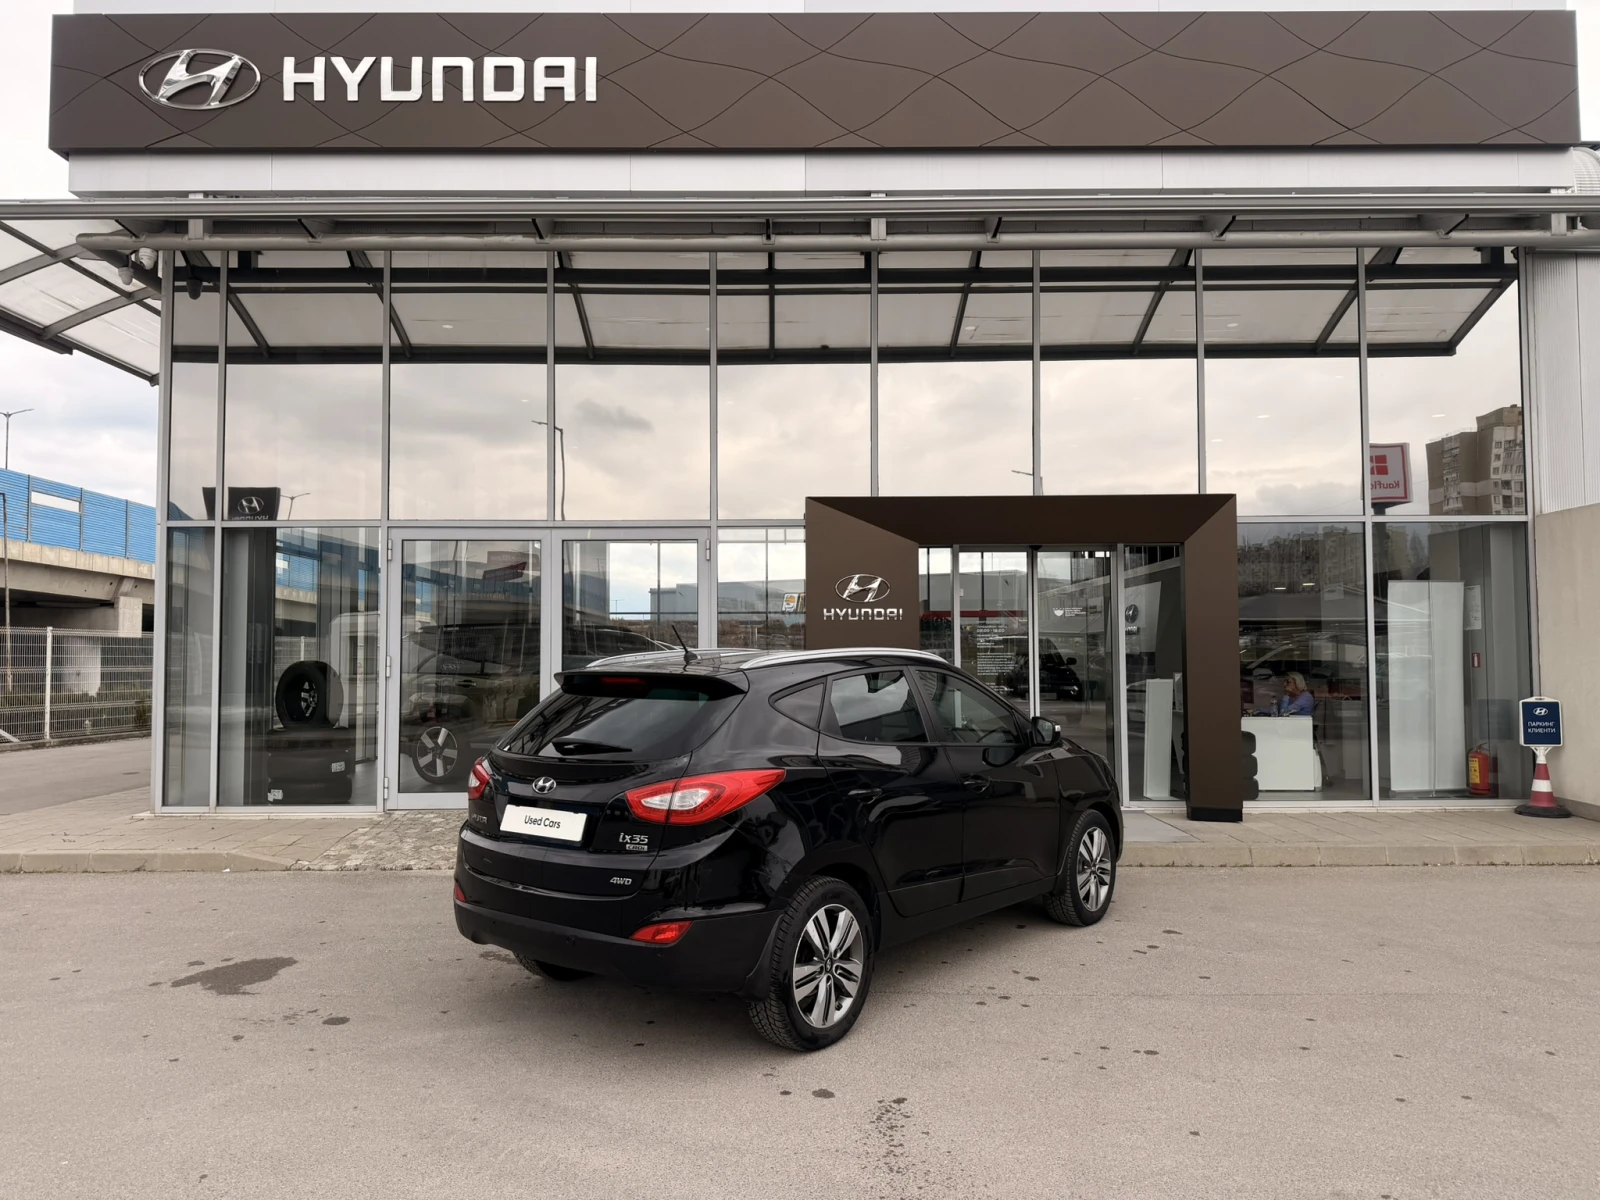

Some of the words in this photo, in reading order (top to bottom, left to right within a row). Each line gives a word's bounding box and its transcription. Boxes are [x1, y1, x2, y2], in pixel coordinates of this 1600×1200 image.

[283, 57, 597, 101] HYUNDAI
[823, 608, 903, 620] HYUNDAI
[524, 815, 542, 826] Used
[543, 818, 561, 829] Cars
[609, 876, 633, 885] 4WD
